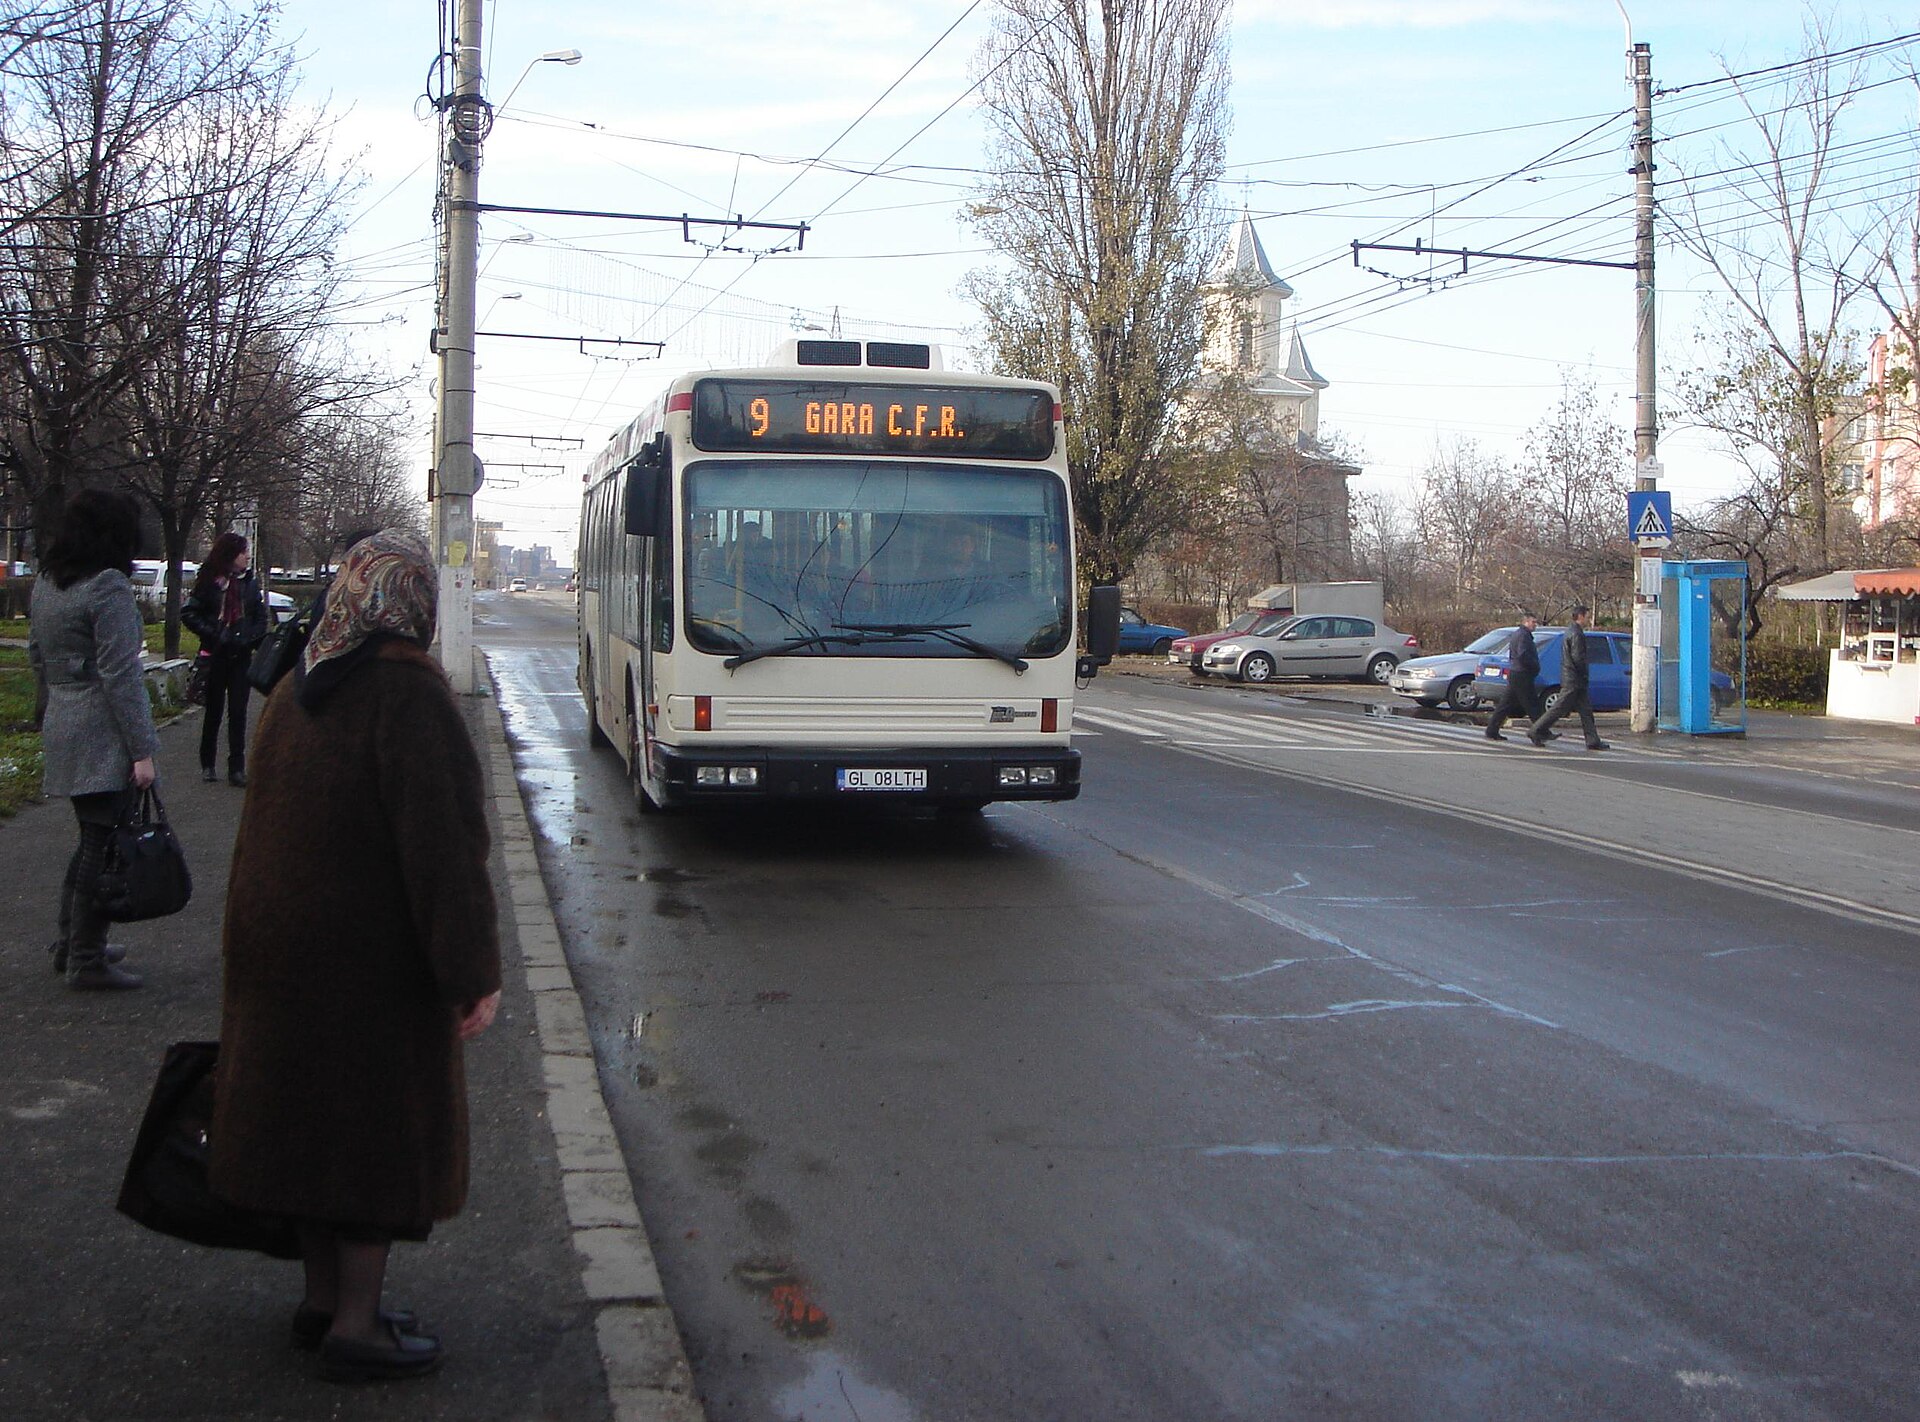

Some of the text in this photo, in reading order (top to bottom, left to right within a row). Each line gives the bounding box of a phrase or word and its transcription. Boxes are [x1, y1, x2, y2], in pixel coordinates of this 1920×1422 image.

[750, 398, 964, 437] 9 GARA C.F.R.
[849, 771, 868, 786] GL
[874, 771, 892, 786] 08
[895, 771, 924, 786] LTH
